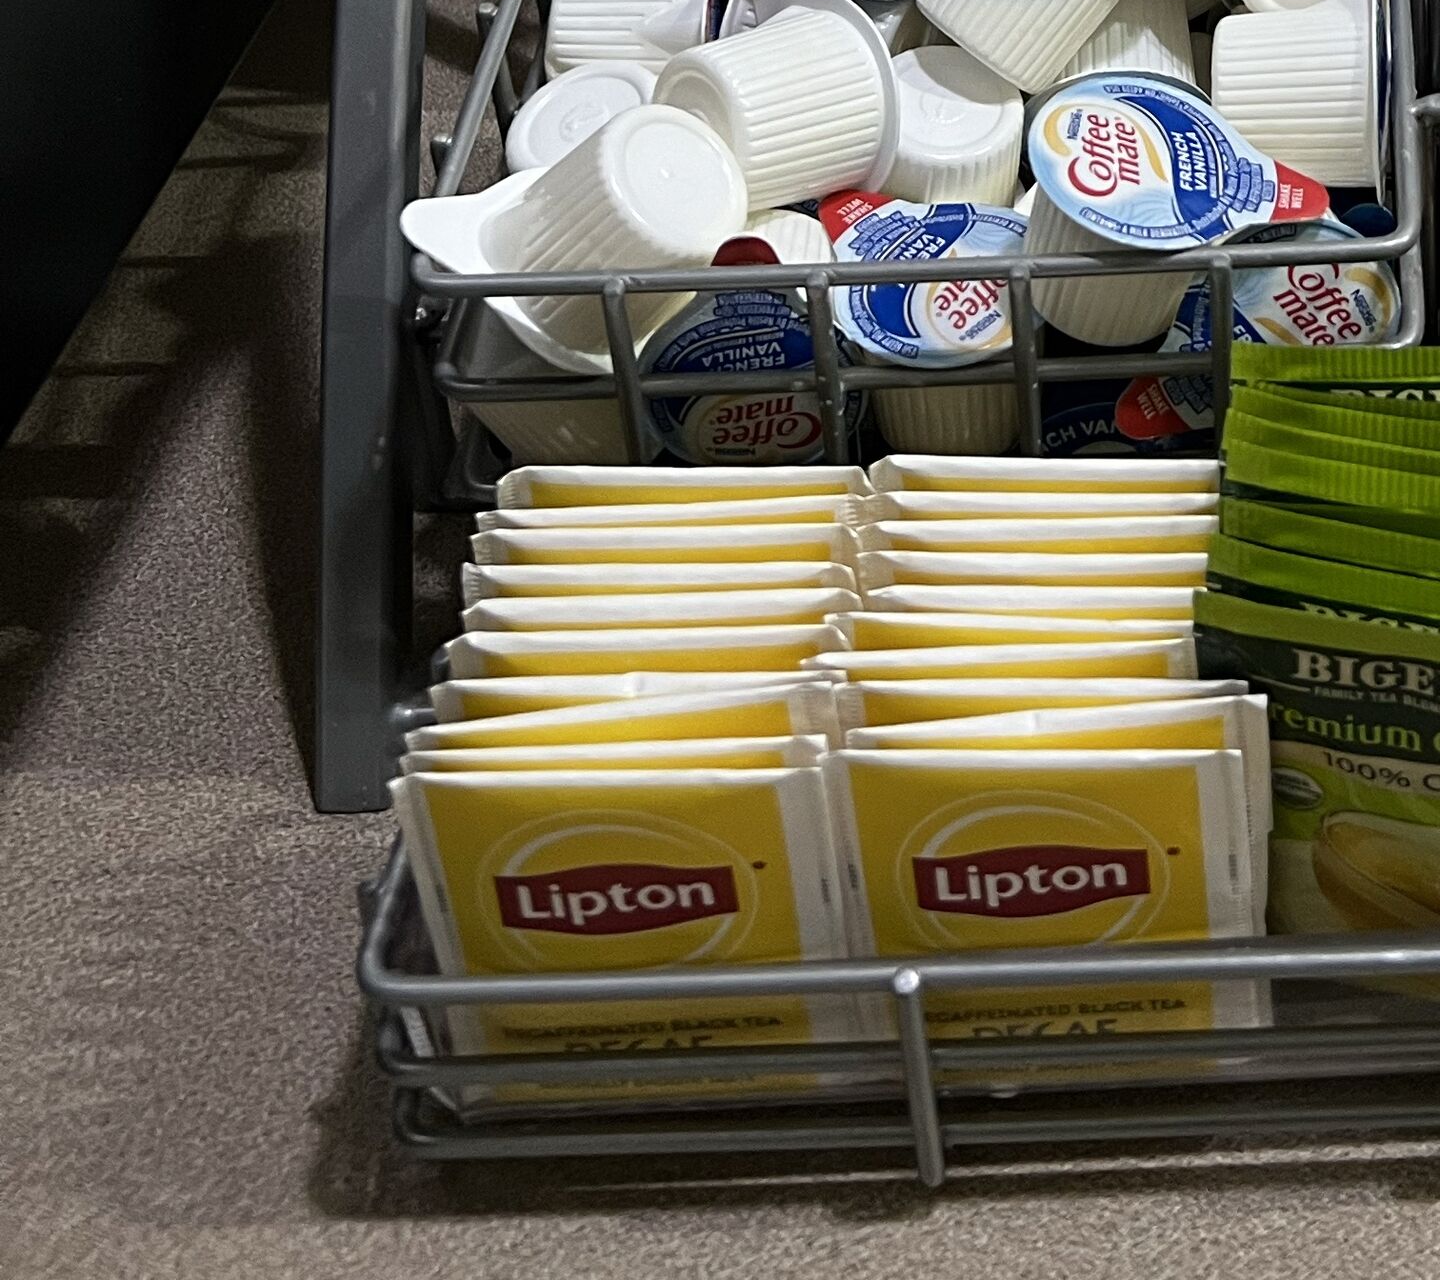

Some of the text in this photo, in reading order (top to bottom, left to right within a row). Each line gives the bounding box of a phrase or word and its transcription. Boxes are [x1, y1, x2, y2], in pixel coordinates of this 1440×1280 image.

[1068, 113, 1118, 197] Coffee
[1115, 122, 1140, 185] mate
[1171, 131, 1193, 192] FRENCH
[1189, 132, 1208, 190] VANILLA
[1278, 183, 1292, 210] SHAKE
[1290, 188, 1304, 209] WELL
[1273, 289, 1336, 347] mate
[1287, 263, 1362, 340] Coffee
[702, 342, 782, 367] VANILLA
[722, 354, 785, 372] FRENC
[716, 395, 794, 424] mate
[712, 412, 823, 450] Coffee
[1313, 685, 1365, 702] FAMILY
[1370, 690, 1397, 705] TEA
[1270, 702, 1421, 754] remium
[1322, 751, 1411, 788] 100%
[516, 879, 716, 926] Lipton
[933, 862, 1129, 909] Lipton
[923, 1004, 1070, 1023] ECAFFEINATED
